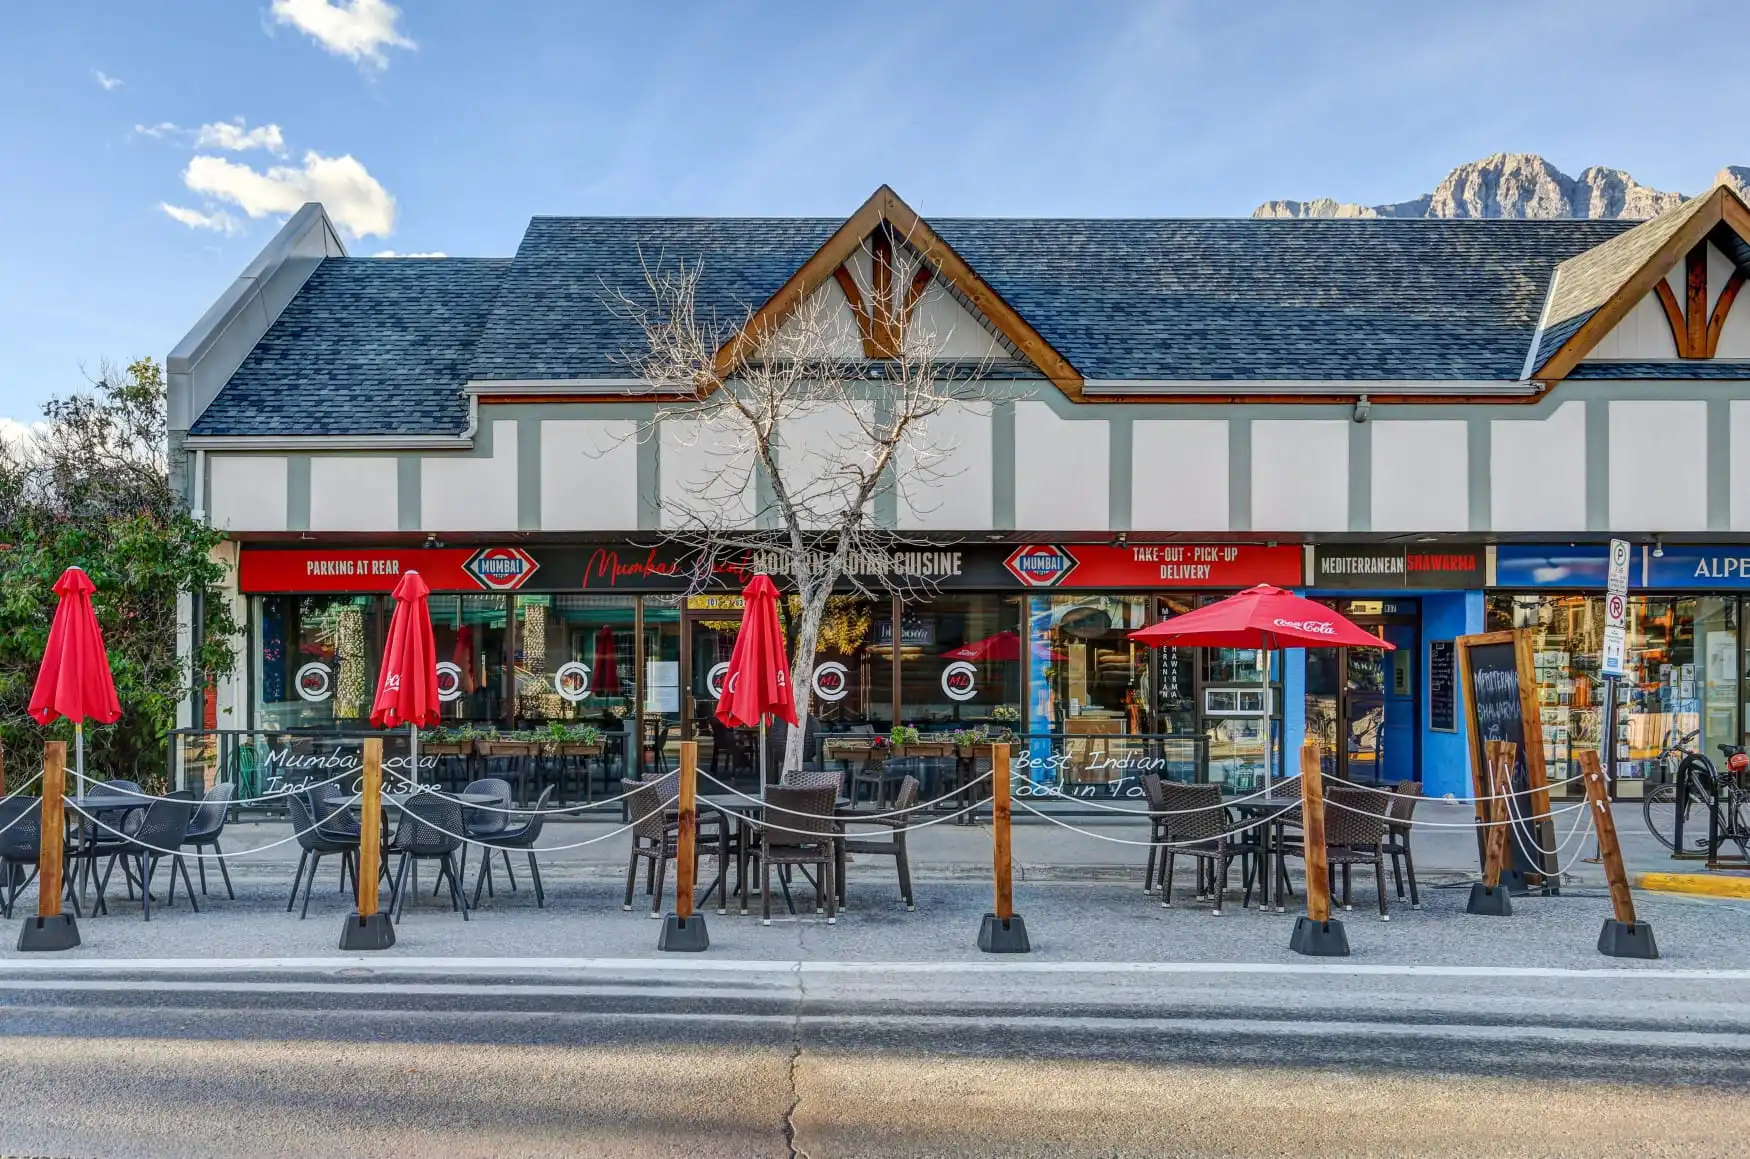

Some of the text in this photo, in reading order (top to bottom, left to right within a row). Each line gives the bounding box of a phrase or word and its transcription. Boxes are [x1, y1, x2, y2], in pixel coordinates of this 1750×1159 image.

[1023, 556, 1061, 570] MUMBAI
[1133, 547, 1238, 562] TAKE-OUT PICK-UP
[1407, 554, 1476, 572] SHAWARMA
[307, 559, 400, 575] PARKING AT REAR
[481, 558, 520, 573] MUMBAI
[582, 547, 680, 589] Mumbai
[894, 551, 963, 576] CUISINE
[1160, 564, 1211, 579] DELIVERY
[1321, 557, 1404, 574] MEDITERRANEAN
[263, 746, 360, 769] Mumbai
[1015, 750, 1166, 770] Best Indian
[1073, 778, 1096, 797] in
[1108, 776, 1147, 798] To
